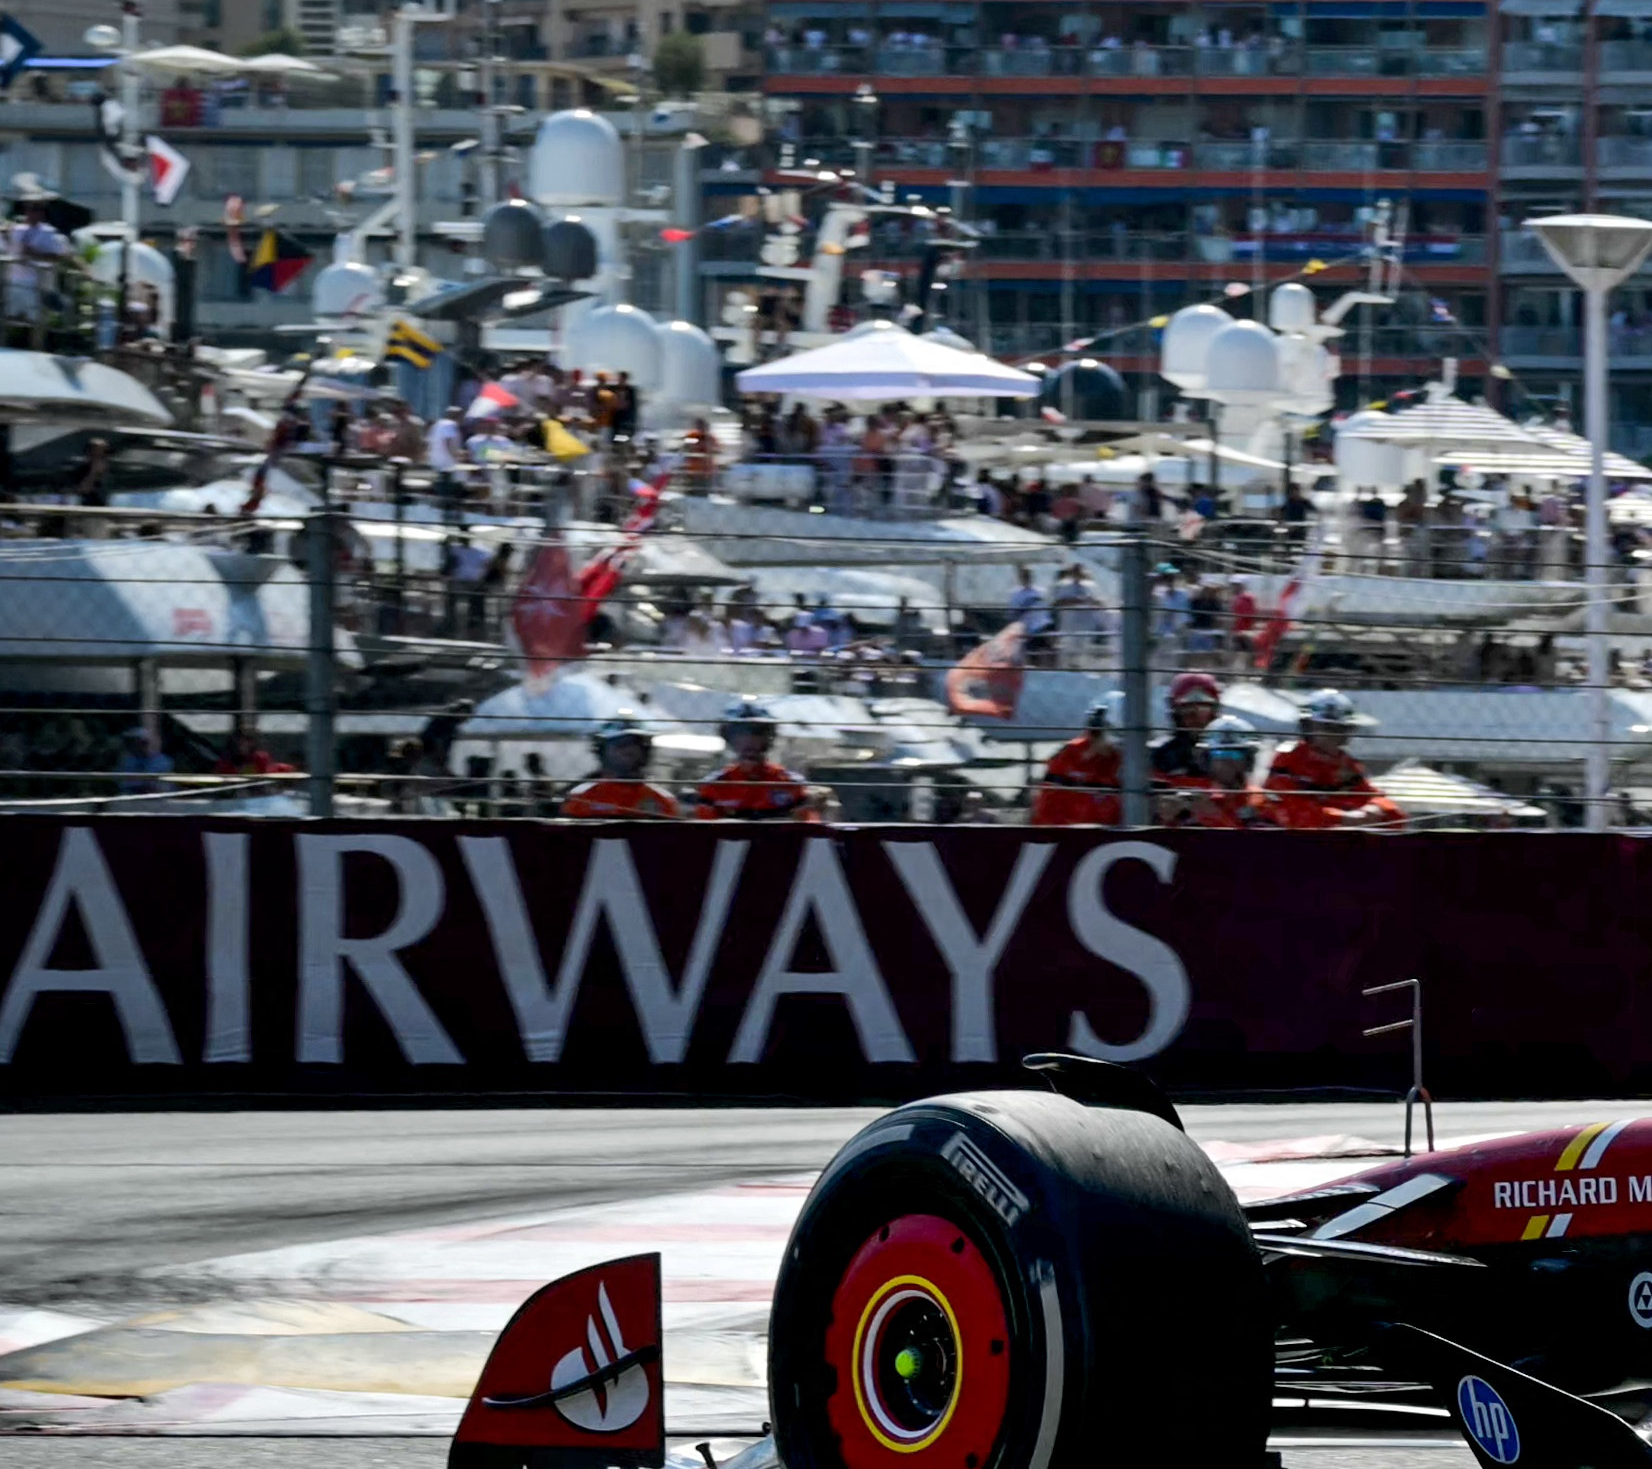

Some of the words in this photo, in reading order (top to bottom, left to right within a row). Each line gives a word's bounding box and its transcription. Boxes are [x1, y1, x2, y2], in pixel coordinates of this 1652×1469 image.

[0, 826, 1192, 1066] AIRWAYS
[1494, 1176, 1618, 1209] RICHARD
[1468, 1375, 1512, 1463] hp
